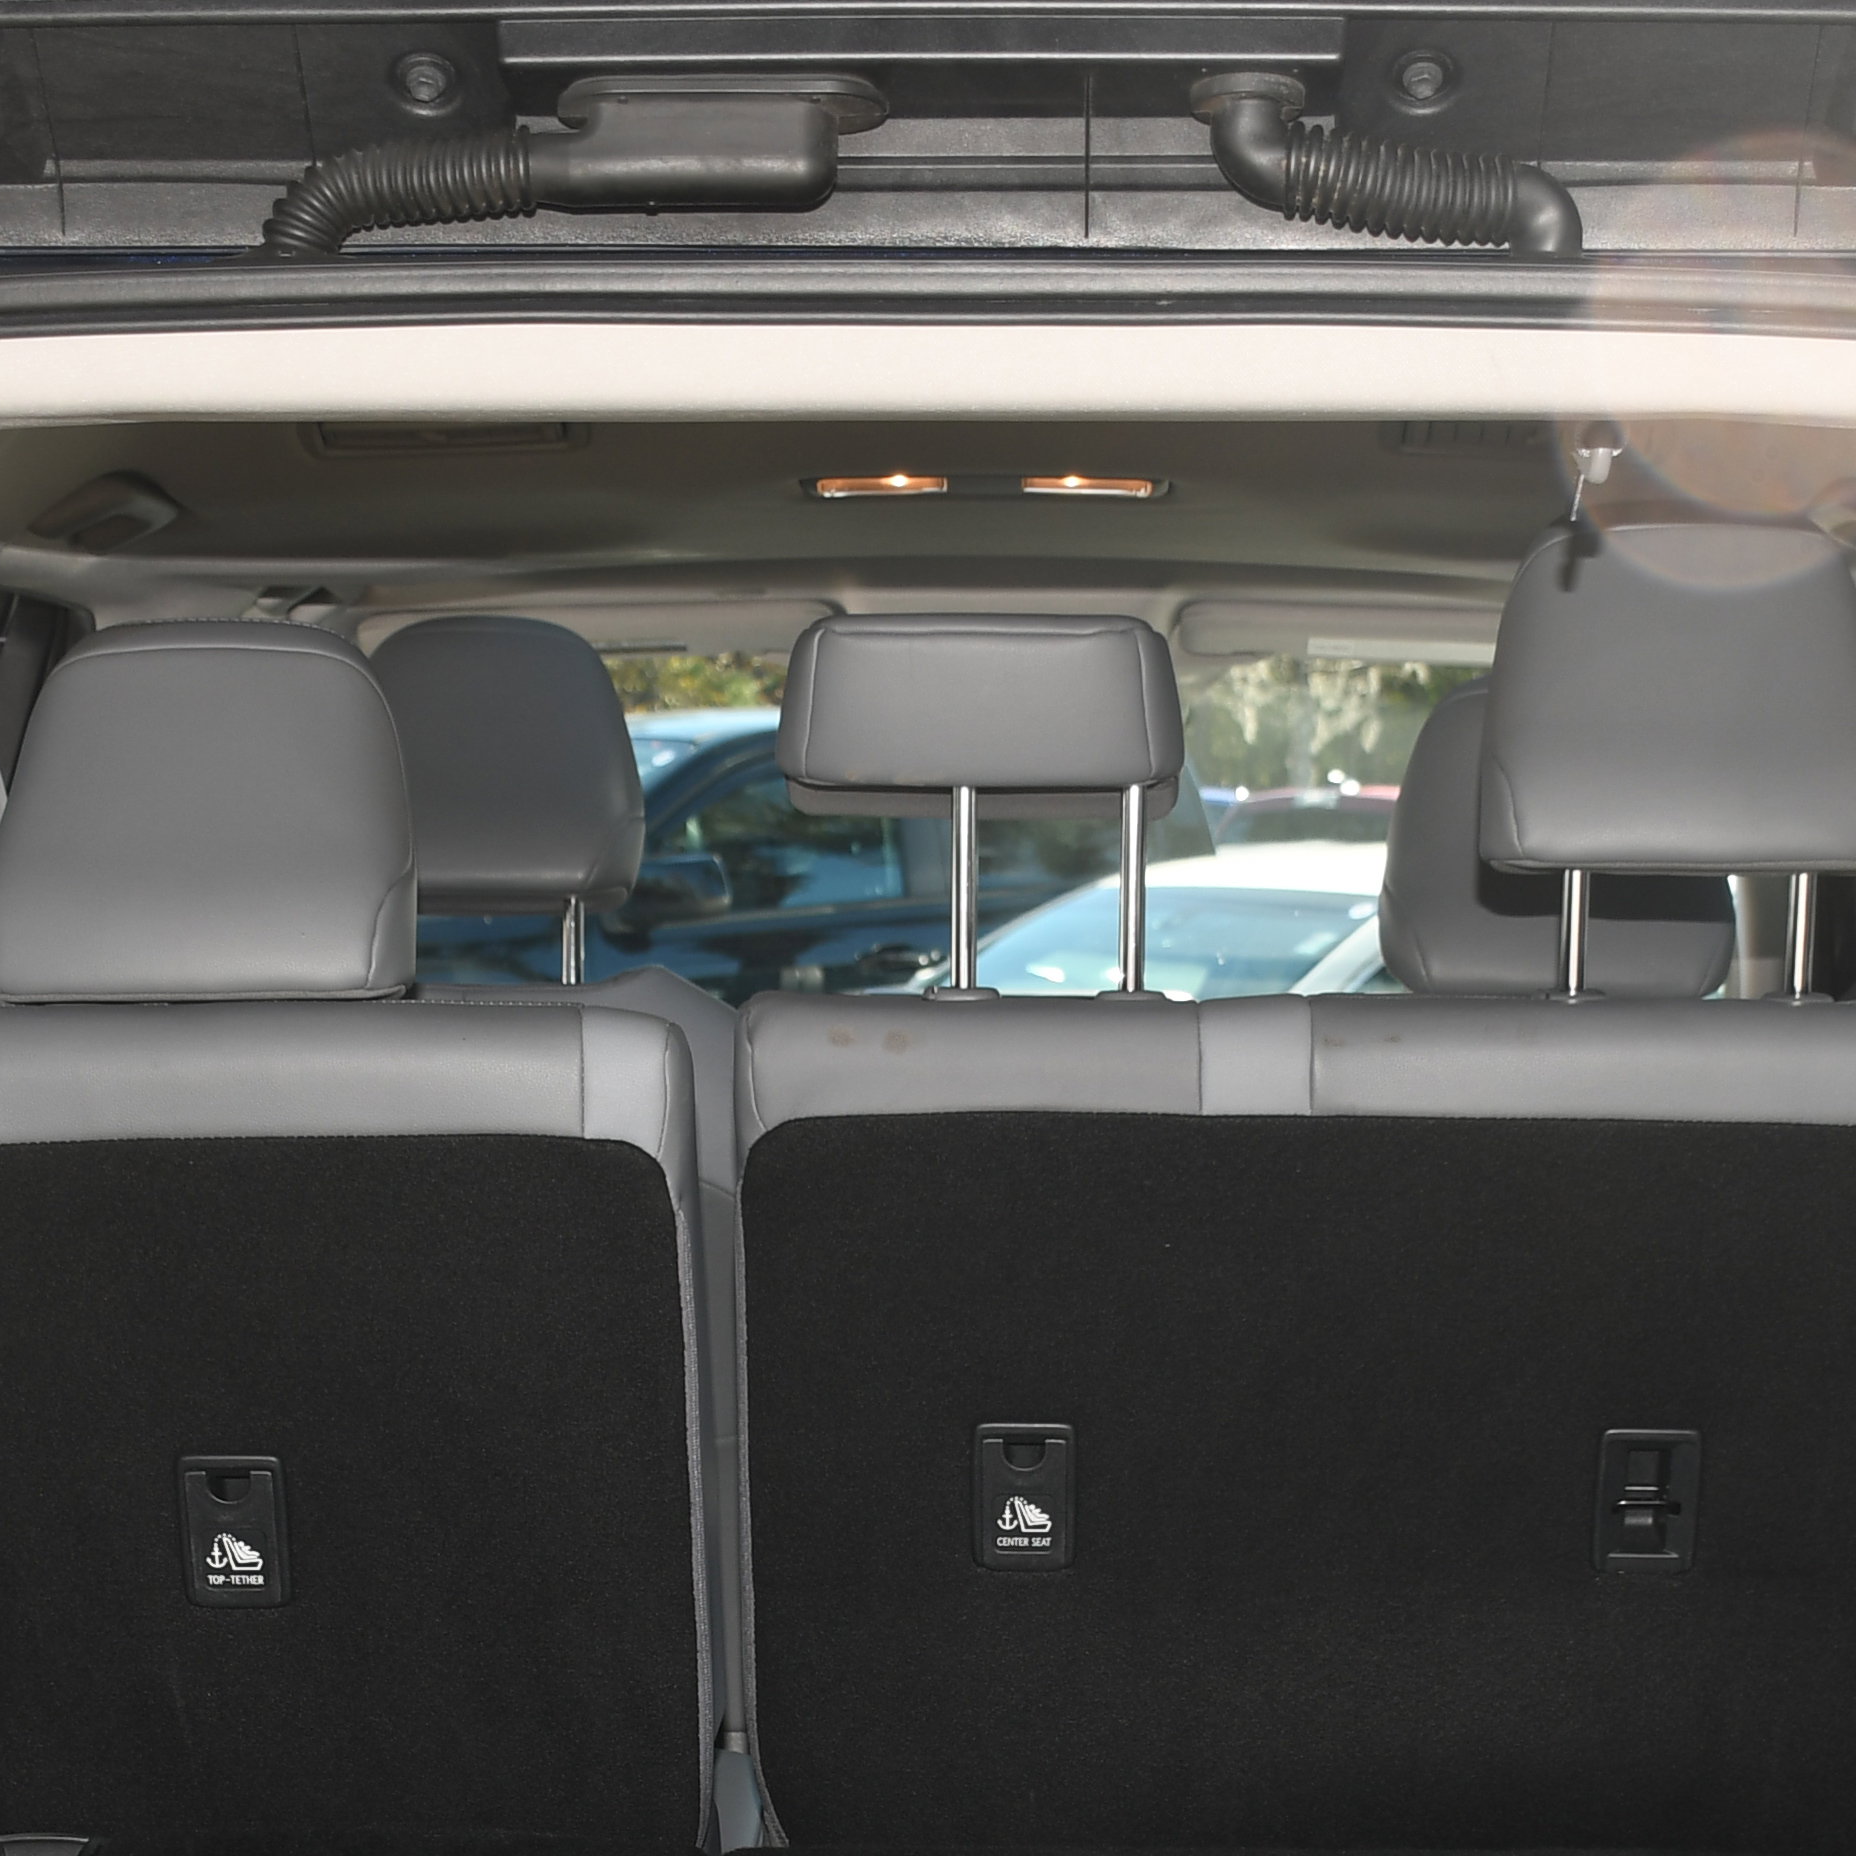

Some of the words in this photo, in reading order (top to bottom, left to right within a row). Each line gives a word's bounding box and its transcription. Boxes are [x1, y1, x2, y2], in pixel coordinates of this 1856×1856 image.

[996, 1537, 1029, 1547] CENTER
[1031, 1537, 1052, 1547] SEAT
[207, 1575, 264, 1585] TOP-TETHER
